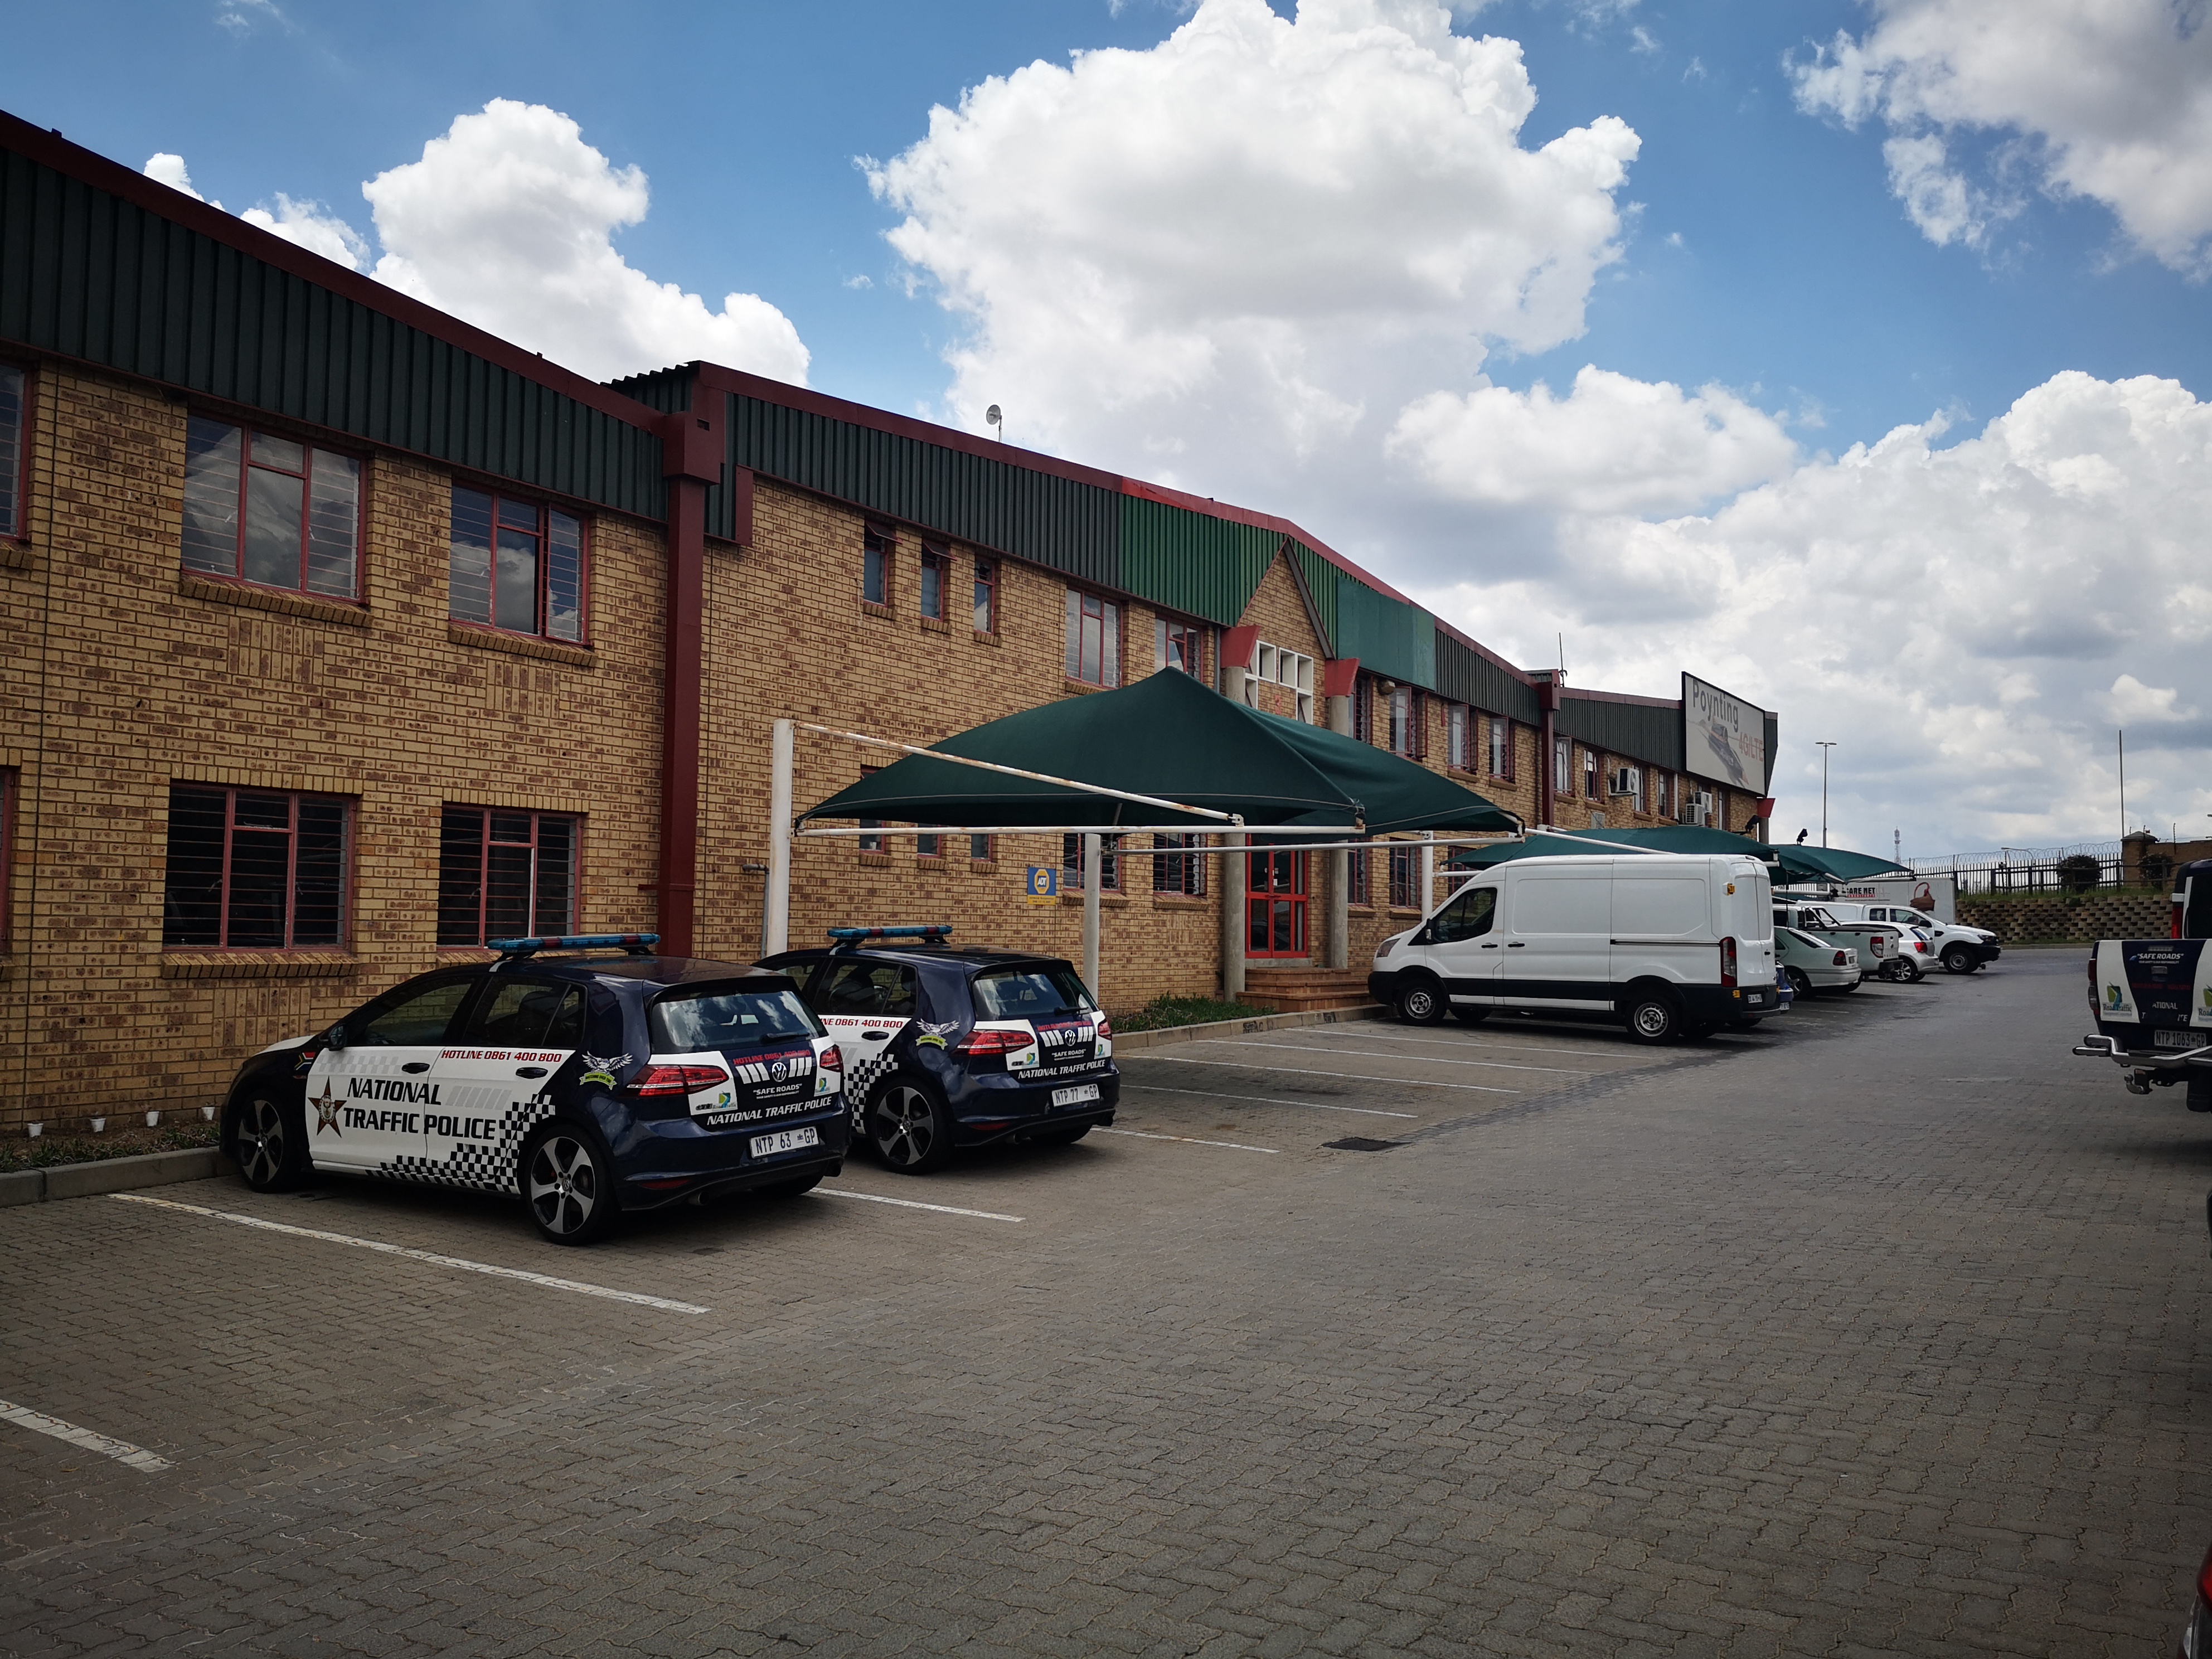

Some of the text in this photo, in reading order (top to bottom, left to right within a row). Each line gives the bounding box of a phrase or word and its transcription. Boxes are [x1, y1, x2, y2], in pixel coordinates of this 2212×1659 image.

[1693, 678, 1738, 733] Poynting
[1037, 877, 1046, 886] ADT
[2156, 1031, 2205, 1047] NTP 1063 GP
[441, 1050, 562, 1063] HOTLINE 0861 400 800
[733, 1055, 763, 1065] HOTLINE
[1018, 1060, 1105, 1079] NATIONAL TRAFFIC POLICE
[347, 1077, 441, 1105] NATIONAL
[1055, 1085, 1097, 1104] NTP 77 GP
[707, 1096, 832, 1126] NATIONAL TRAFFIC POLICE
[343, 1108, 419, 1133] TRAFFIC
[424, 1114, 496, 1140] POLICE
[755, 1128, 816, 1154] NTP 63 GP
